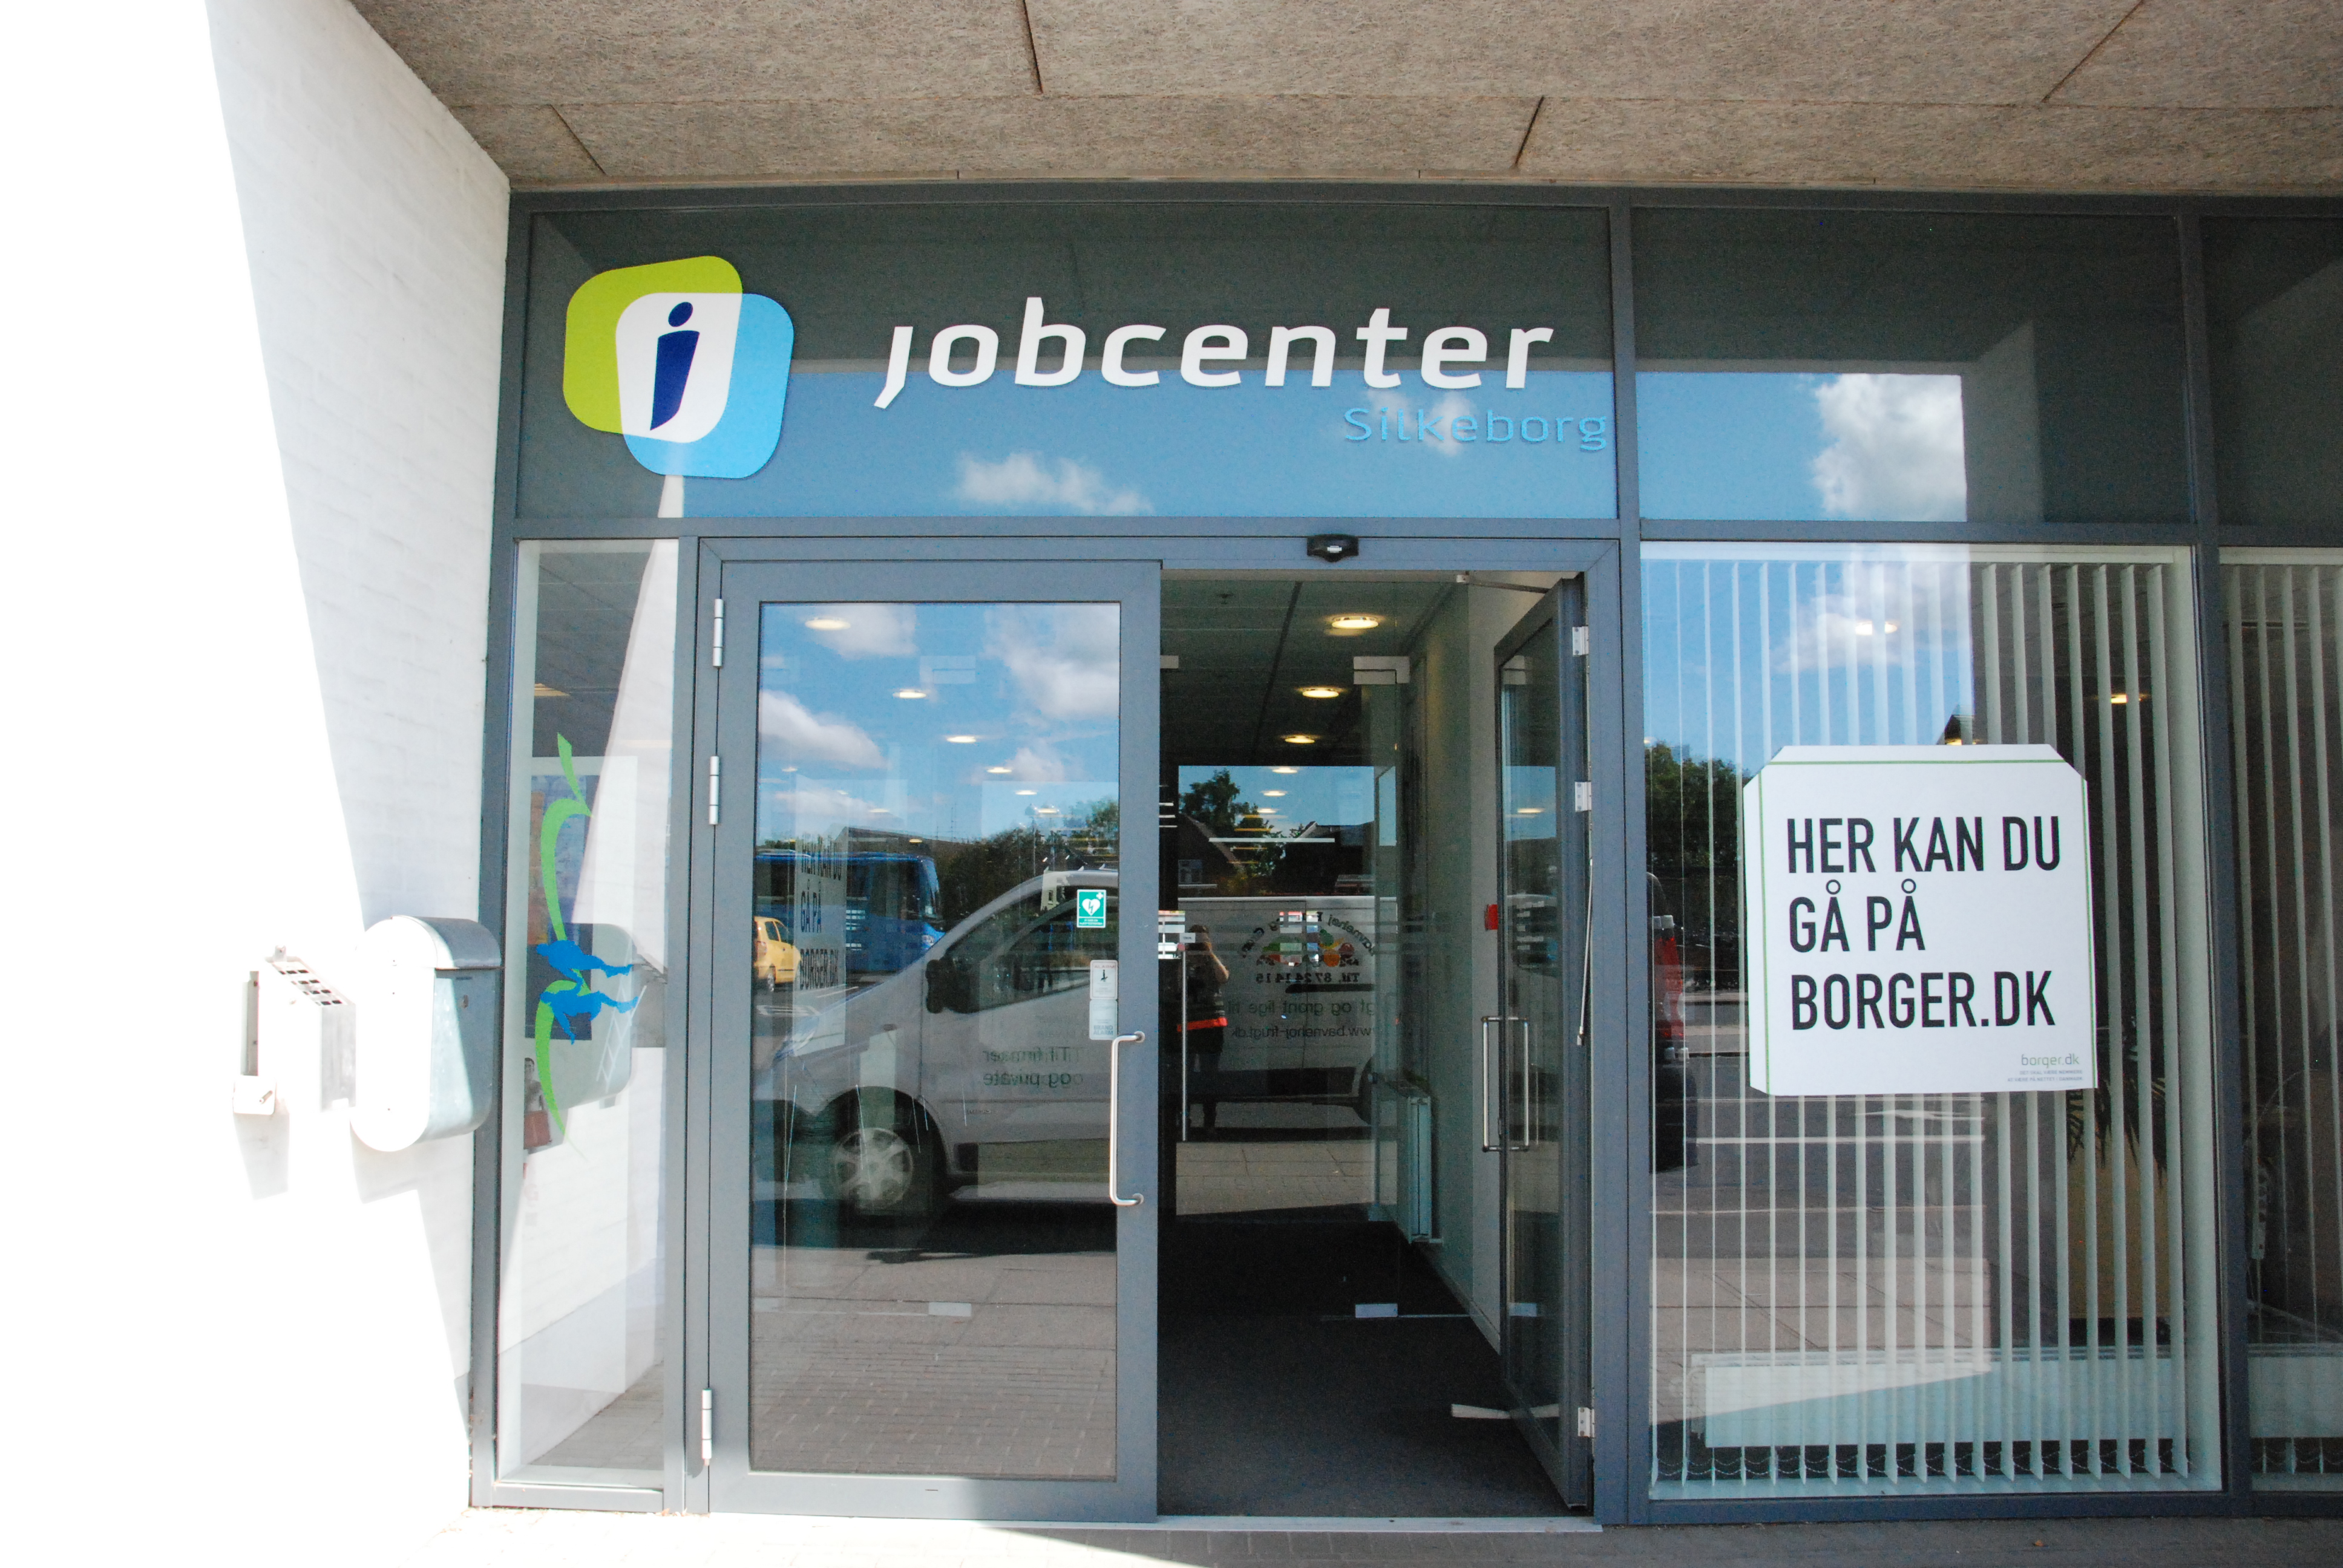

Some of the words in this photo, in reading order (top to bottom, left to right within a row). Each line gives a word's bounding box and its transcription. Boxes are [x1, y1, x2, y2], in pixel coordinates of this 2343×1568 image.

[874, 296, 1555, 409] jobcenter
[1342, 406, 1609, 451] Silkeborg
[1787, 817, 1876, 874] HER
[1893, 816, 1985, 872] KAN
[2002, 815, 2060, 871] DU
[1788, 879, 1850, 953] GÅ
[1866, 878, 1926, 952] PÅ
[1791, 970, 2056, 1030] BORGER.DK
[2021, 1053, 2080, 1069] borger.dk
